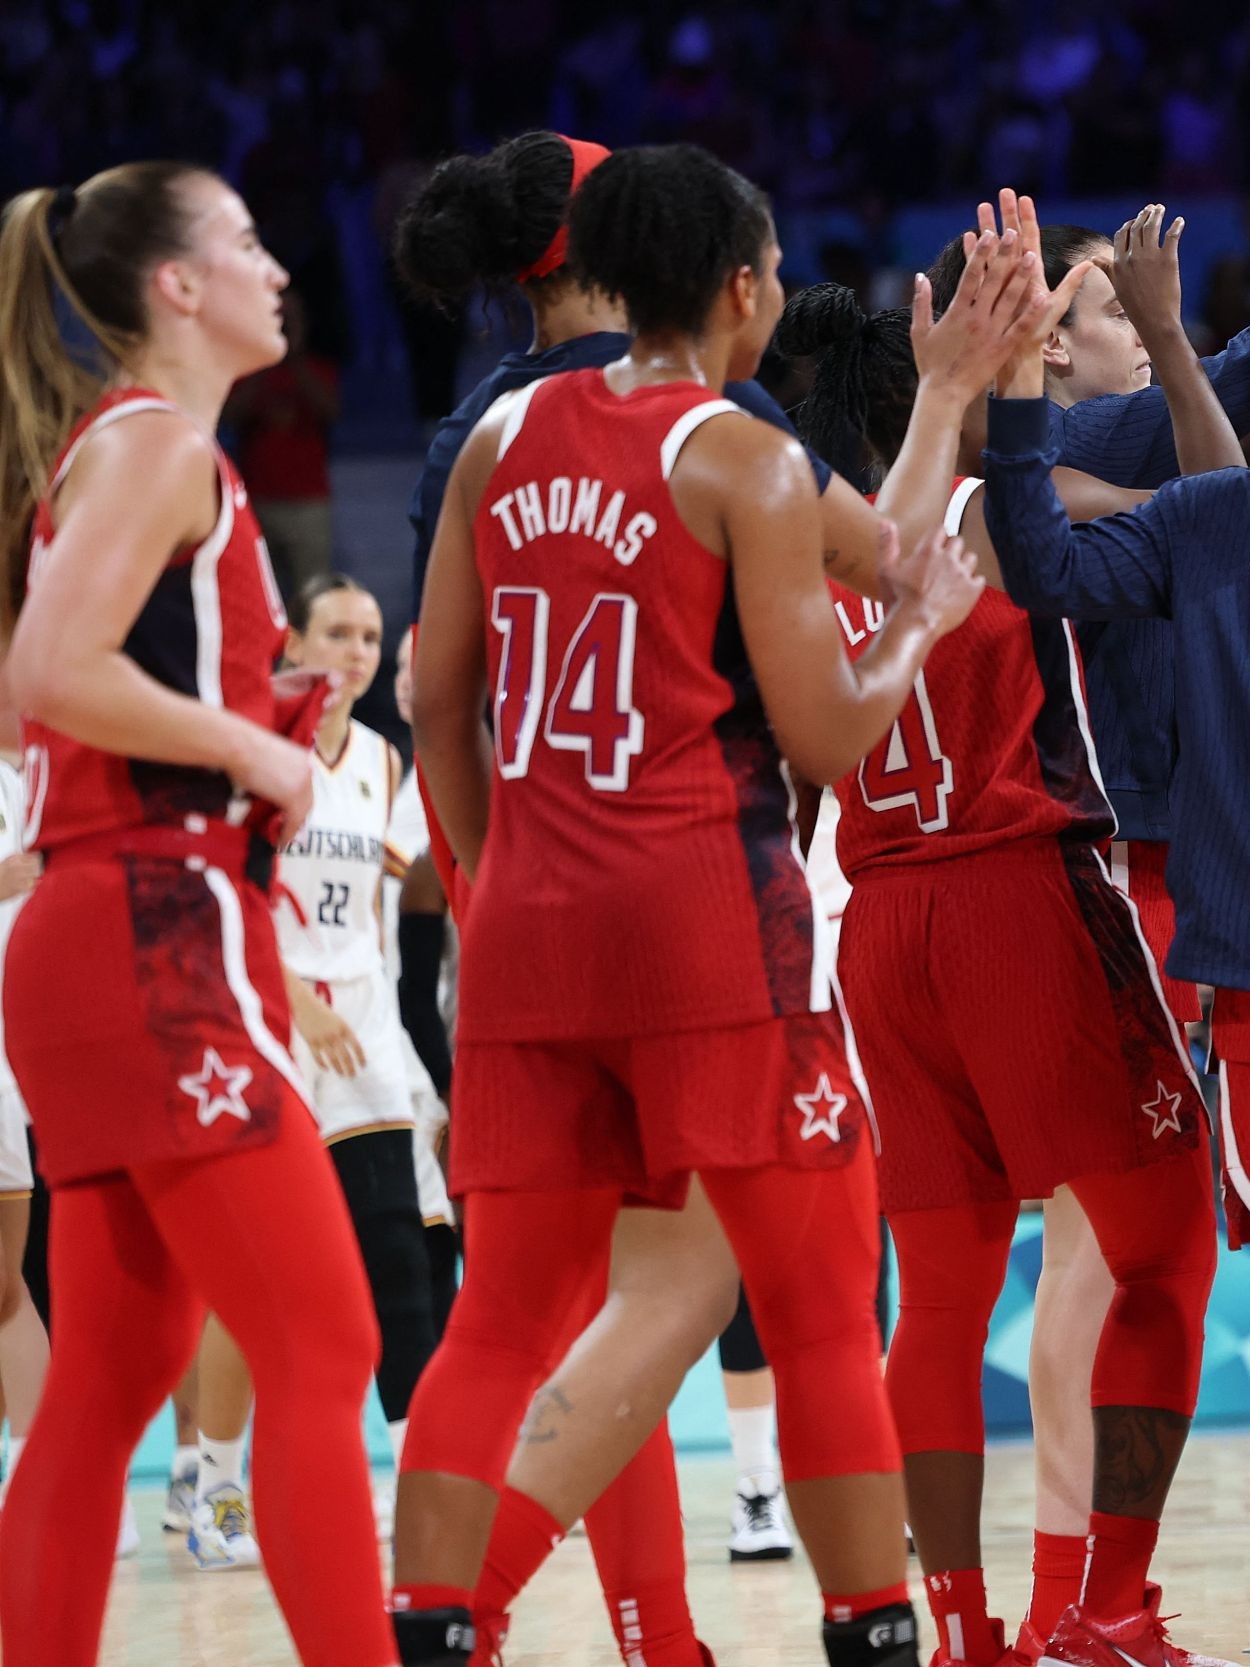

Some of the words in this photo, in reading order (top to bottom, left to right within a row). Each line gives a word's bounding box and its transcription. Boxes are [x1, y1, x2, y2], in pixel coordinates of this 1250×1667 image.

[490, 476, 657, 566] THOMAS
[491, 586, 645, 792] 14
[858, 667, 954, 834] 4
[318, 881, 349, 926] 22
